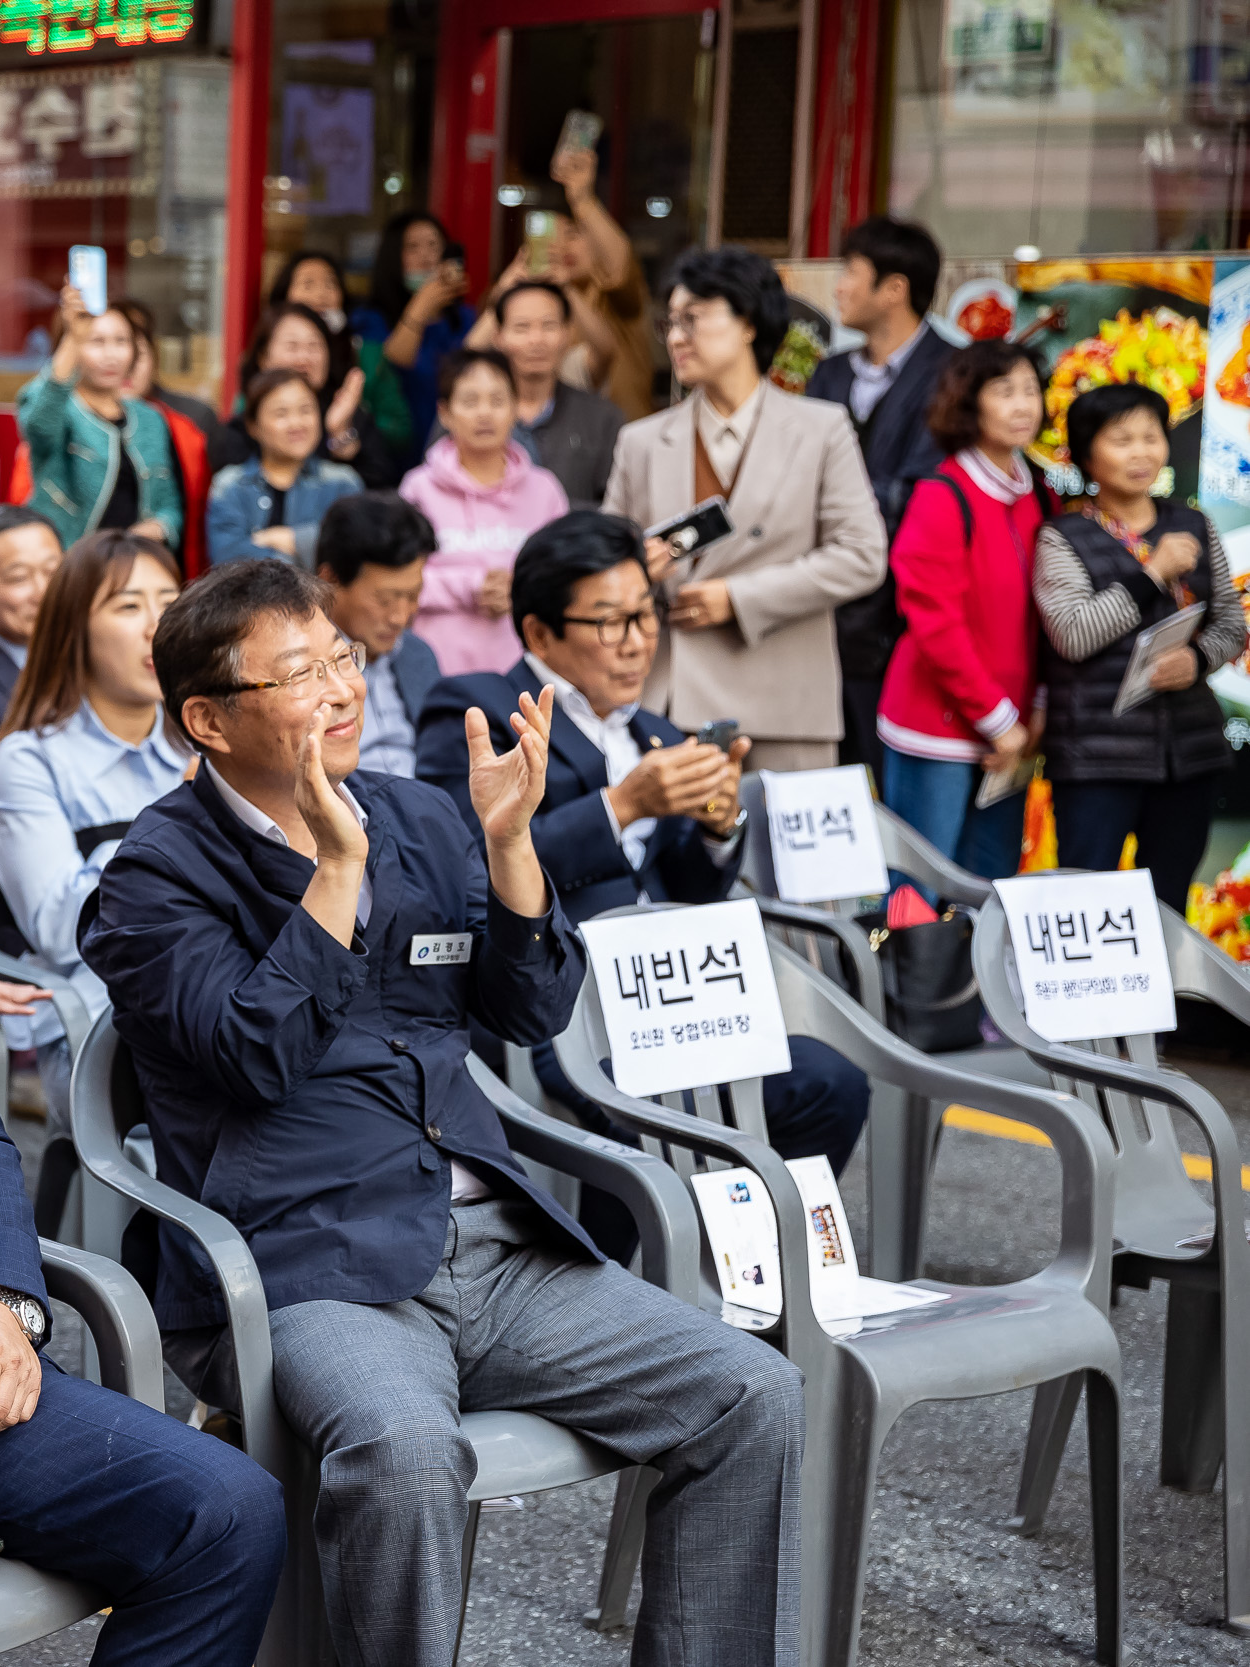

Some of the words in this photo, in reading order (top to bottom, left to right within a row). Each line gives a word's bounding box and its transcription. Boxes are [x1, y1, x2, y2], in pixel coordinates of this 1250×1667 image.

[1025, 906, 1139, 964] 내빈석
[614, 941, 746, 1010] 내빈석
[1121, 973, 1150, 993] 의장
[670, 1014, 751, 1044] 당협위원장
